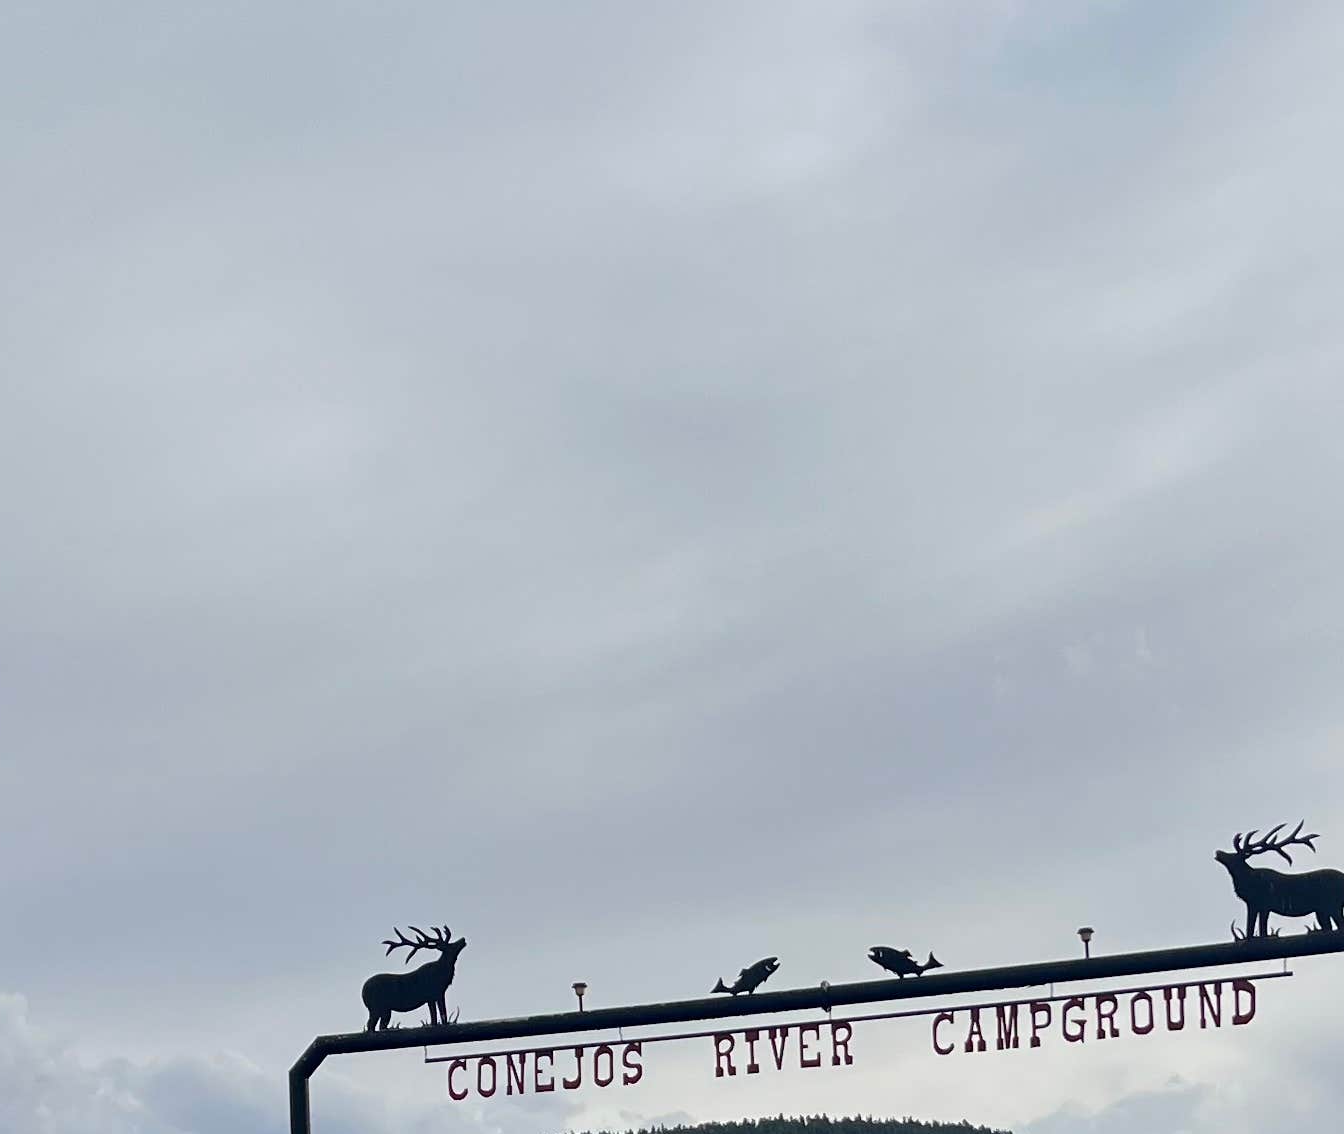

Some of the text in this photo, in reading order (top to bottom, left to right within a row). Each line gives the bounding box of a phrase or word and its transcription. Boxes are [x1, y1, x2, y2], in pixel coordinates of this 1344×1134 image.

[448, 978, 1256, 1100] CONEJOS RIVER CAMPGROUND
